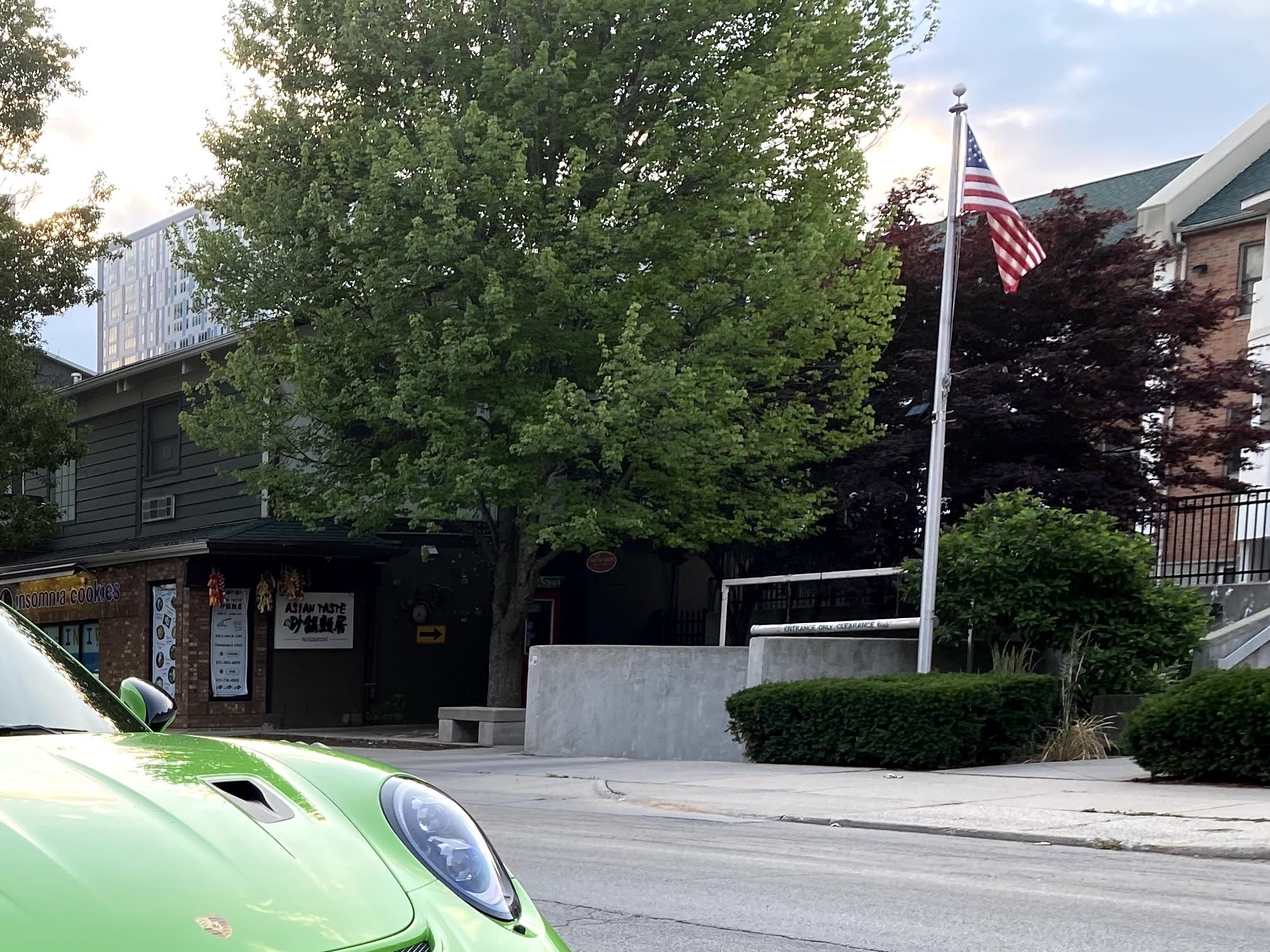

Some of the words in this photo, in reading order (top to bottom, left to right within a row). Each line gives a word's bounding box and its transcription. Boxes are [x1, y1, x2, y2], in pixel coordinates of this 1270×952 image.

[15, 585, 67, 611] insomnia
[70, 579, 121, 605] cookies
[284, 602, 315, 614] ASIAN
[317, 602, 347, 615] TASTE
[784, 624, 816, 632] ENTRANCE
[836, 621, 875, 630] CLEARANCE
